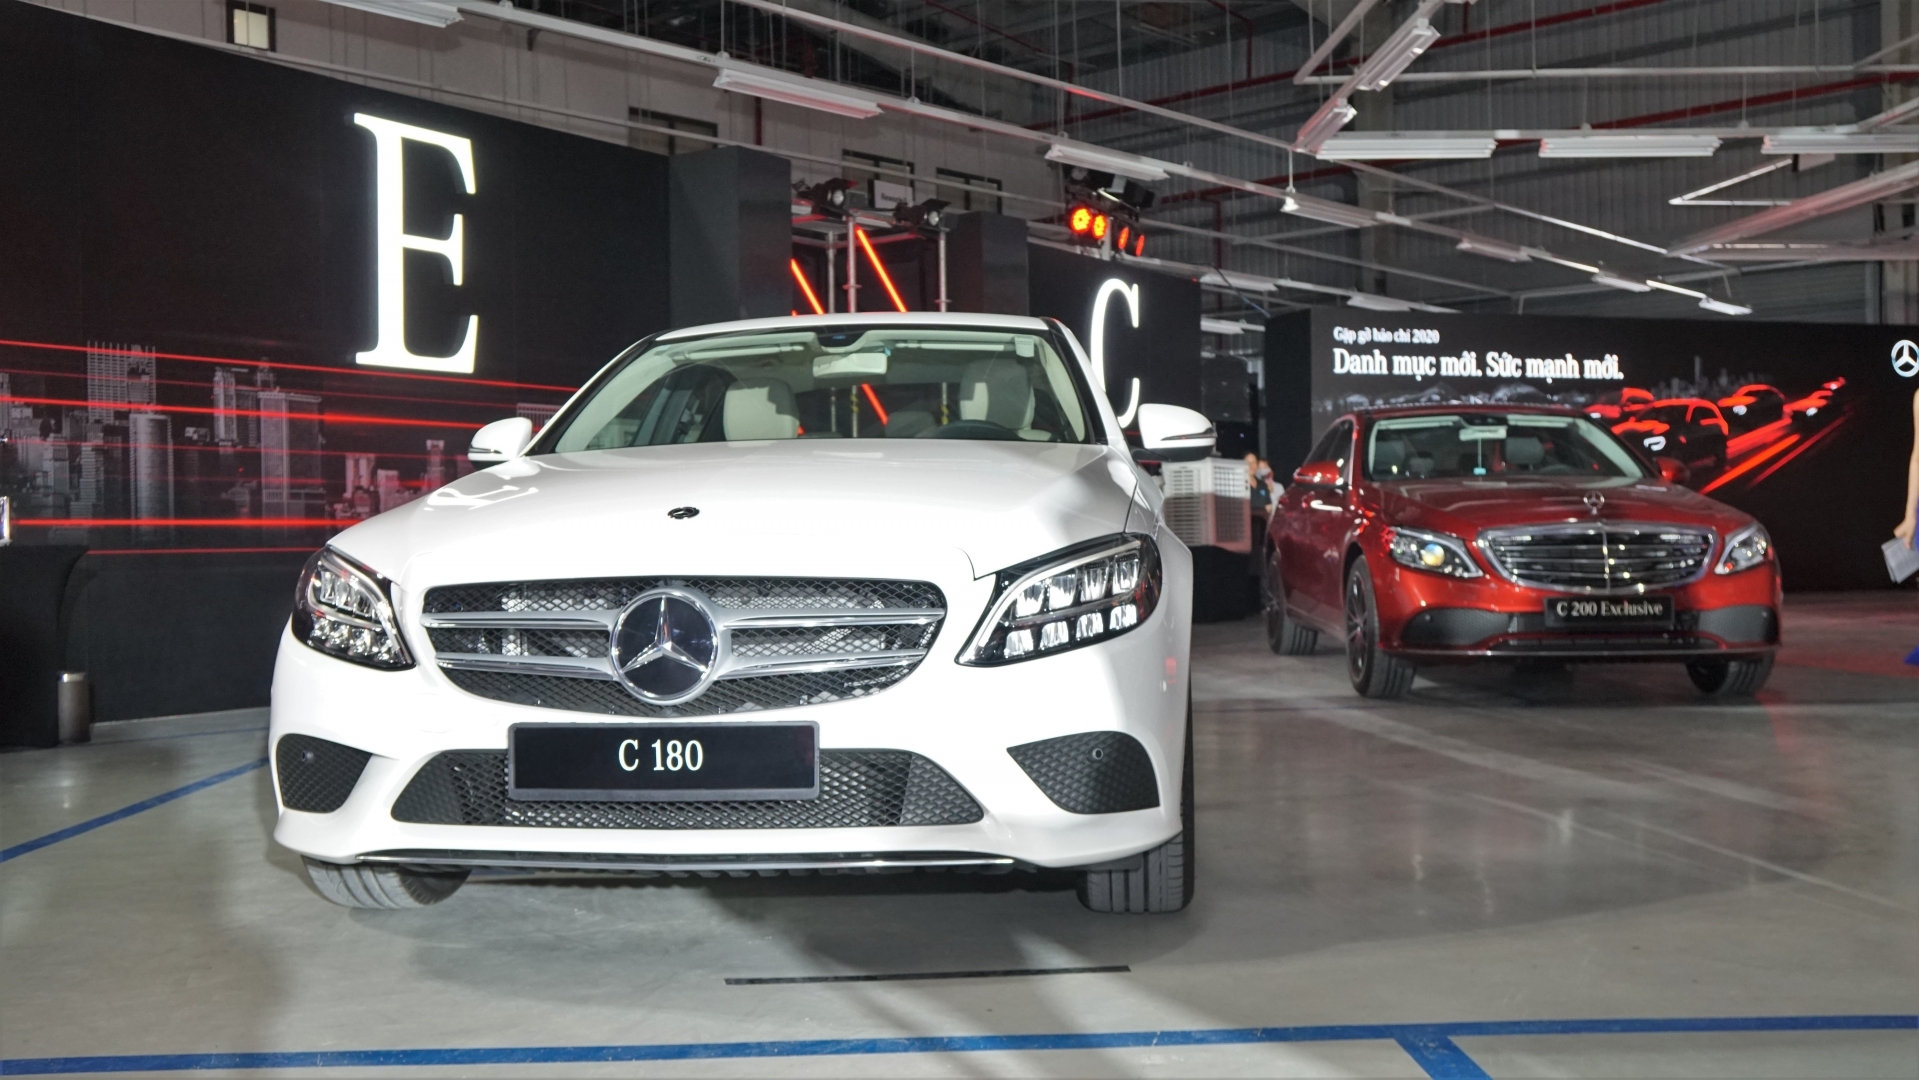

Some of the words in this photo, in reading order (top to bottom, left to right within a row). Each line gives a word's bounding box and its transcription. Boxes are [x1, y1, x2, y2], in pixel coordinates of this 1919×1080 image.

[354, 112, 479, 374] E
[1090, 278, 1140, 429] C
[1412, 328, 1440, 344] 2020
[1332, 347, 1389, 375] Danh
[1391, 354, 1437, 382] mục
[1439, 350, 1483, 377] mới.
[1485, 351, 1523, 378] Sức
[1525, 353, 1581, 384] mạnh
[1583, 353, 1625, 380] mới.
[1556, 601, 1569, 617] C
[1571, 601, 1598, 617] 200
[1600, 600, 1663, 617] Exclusive
[618, 739, 639, 771] C
[651, 739, 704, 772] 180
